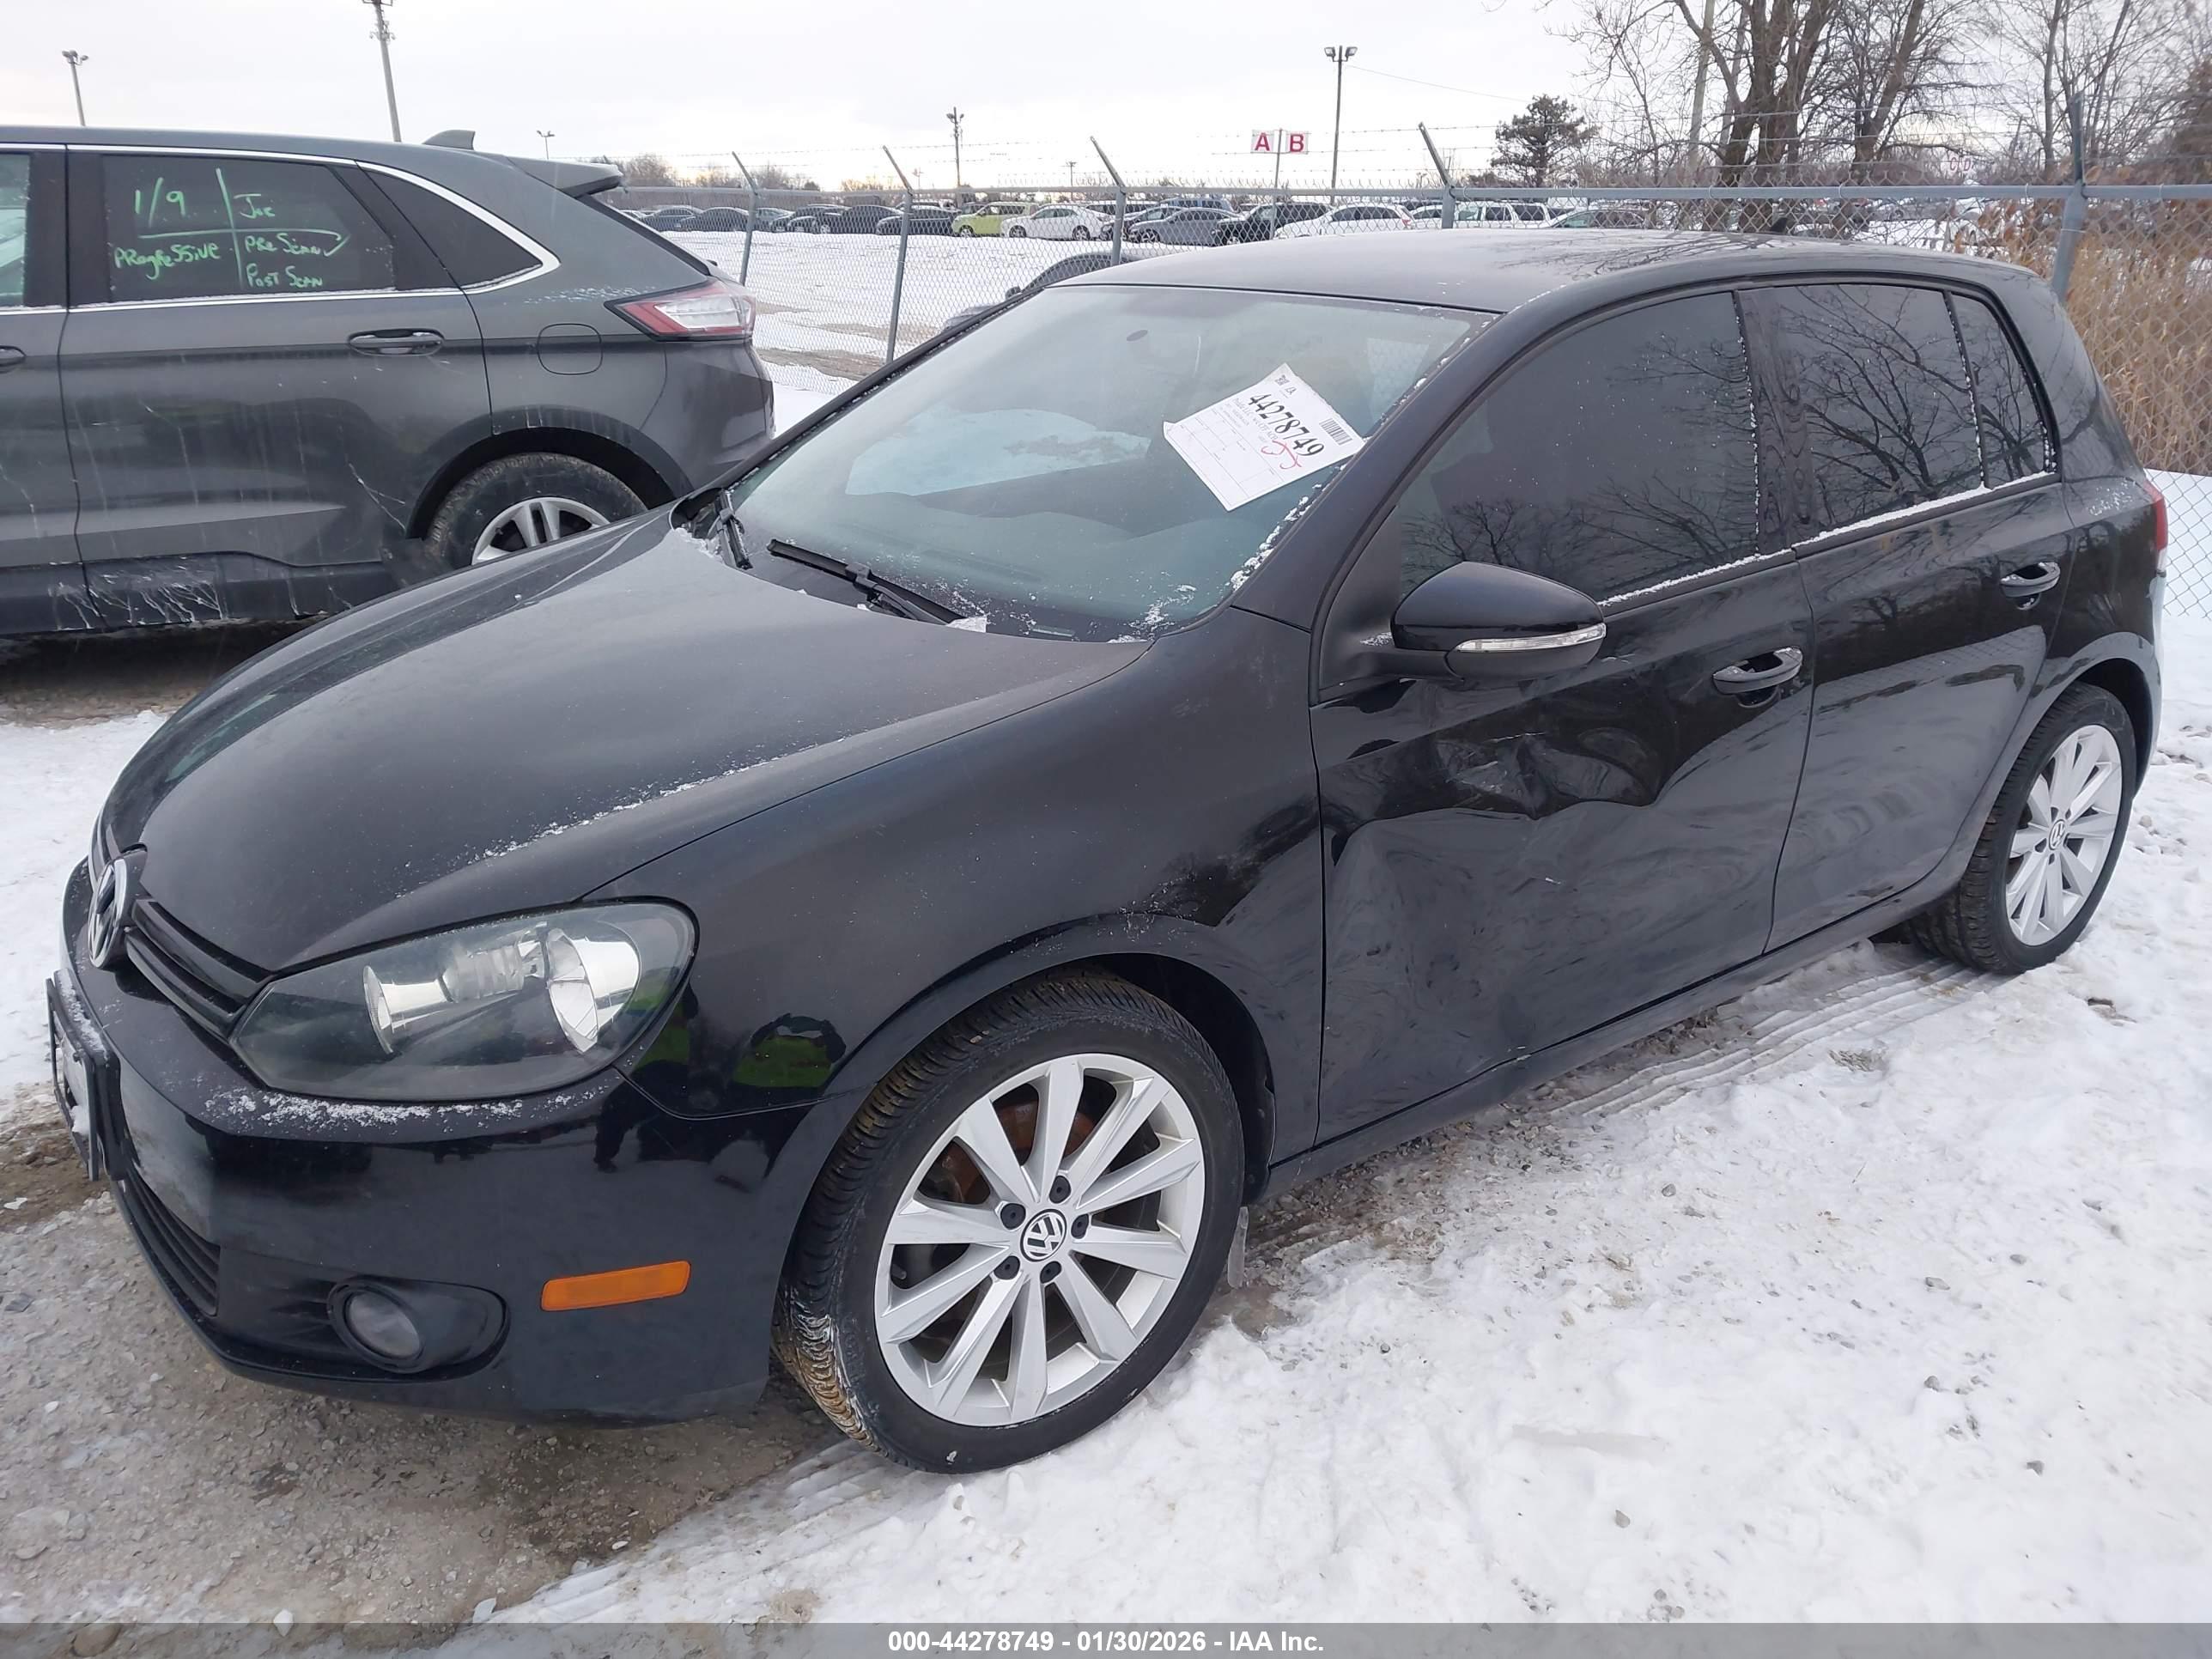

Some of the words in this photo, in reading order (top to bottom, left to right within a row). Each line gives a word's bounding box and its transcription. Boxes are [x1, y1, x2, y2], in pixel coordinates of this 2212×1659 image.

[1255, 132, 1270, 151] A
[1290, 134, 1304, 152] B
[134, 177, 186, 228] 1/9
[1248, 393, 1325, 457] 44278749
